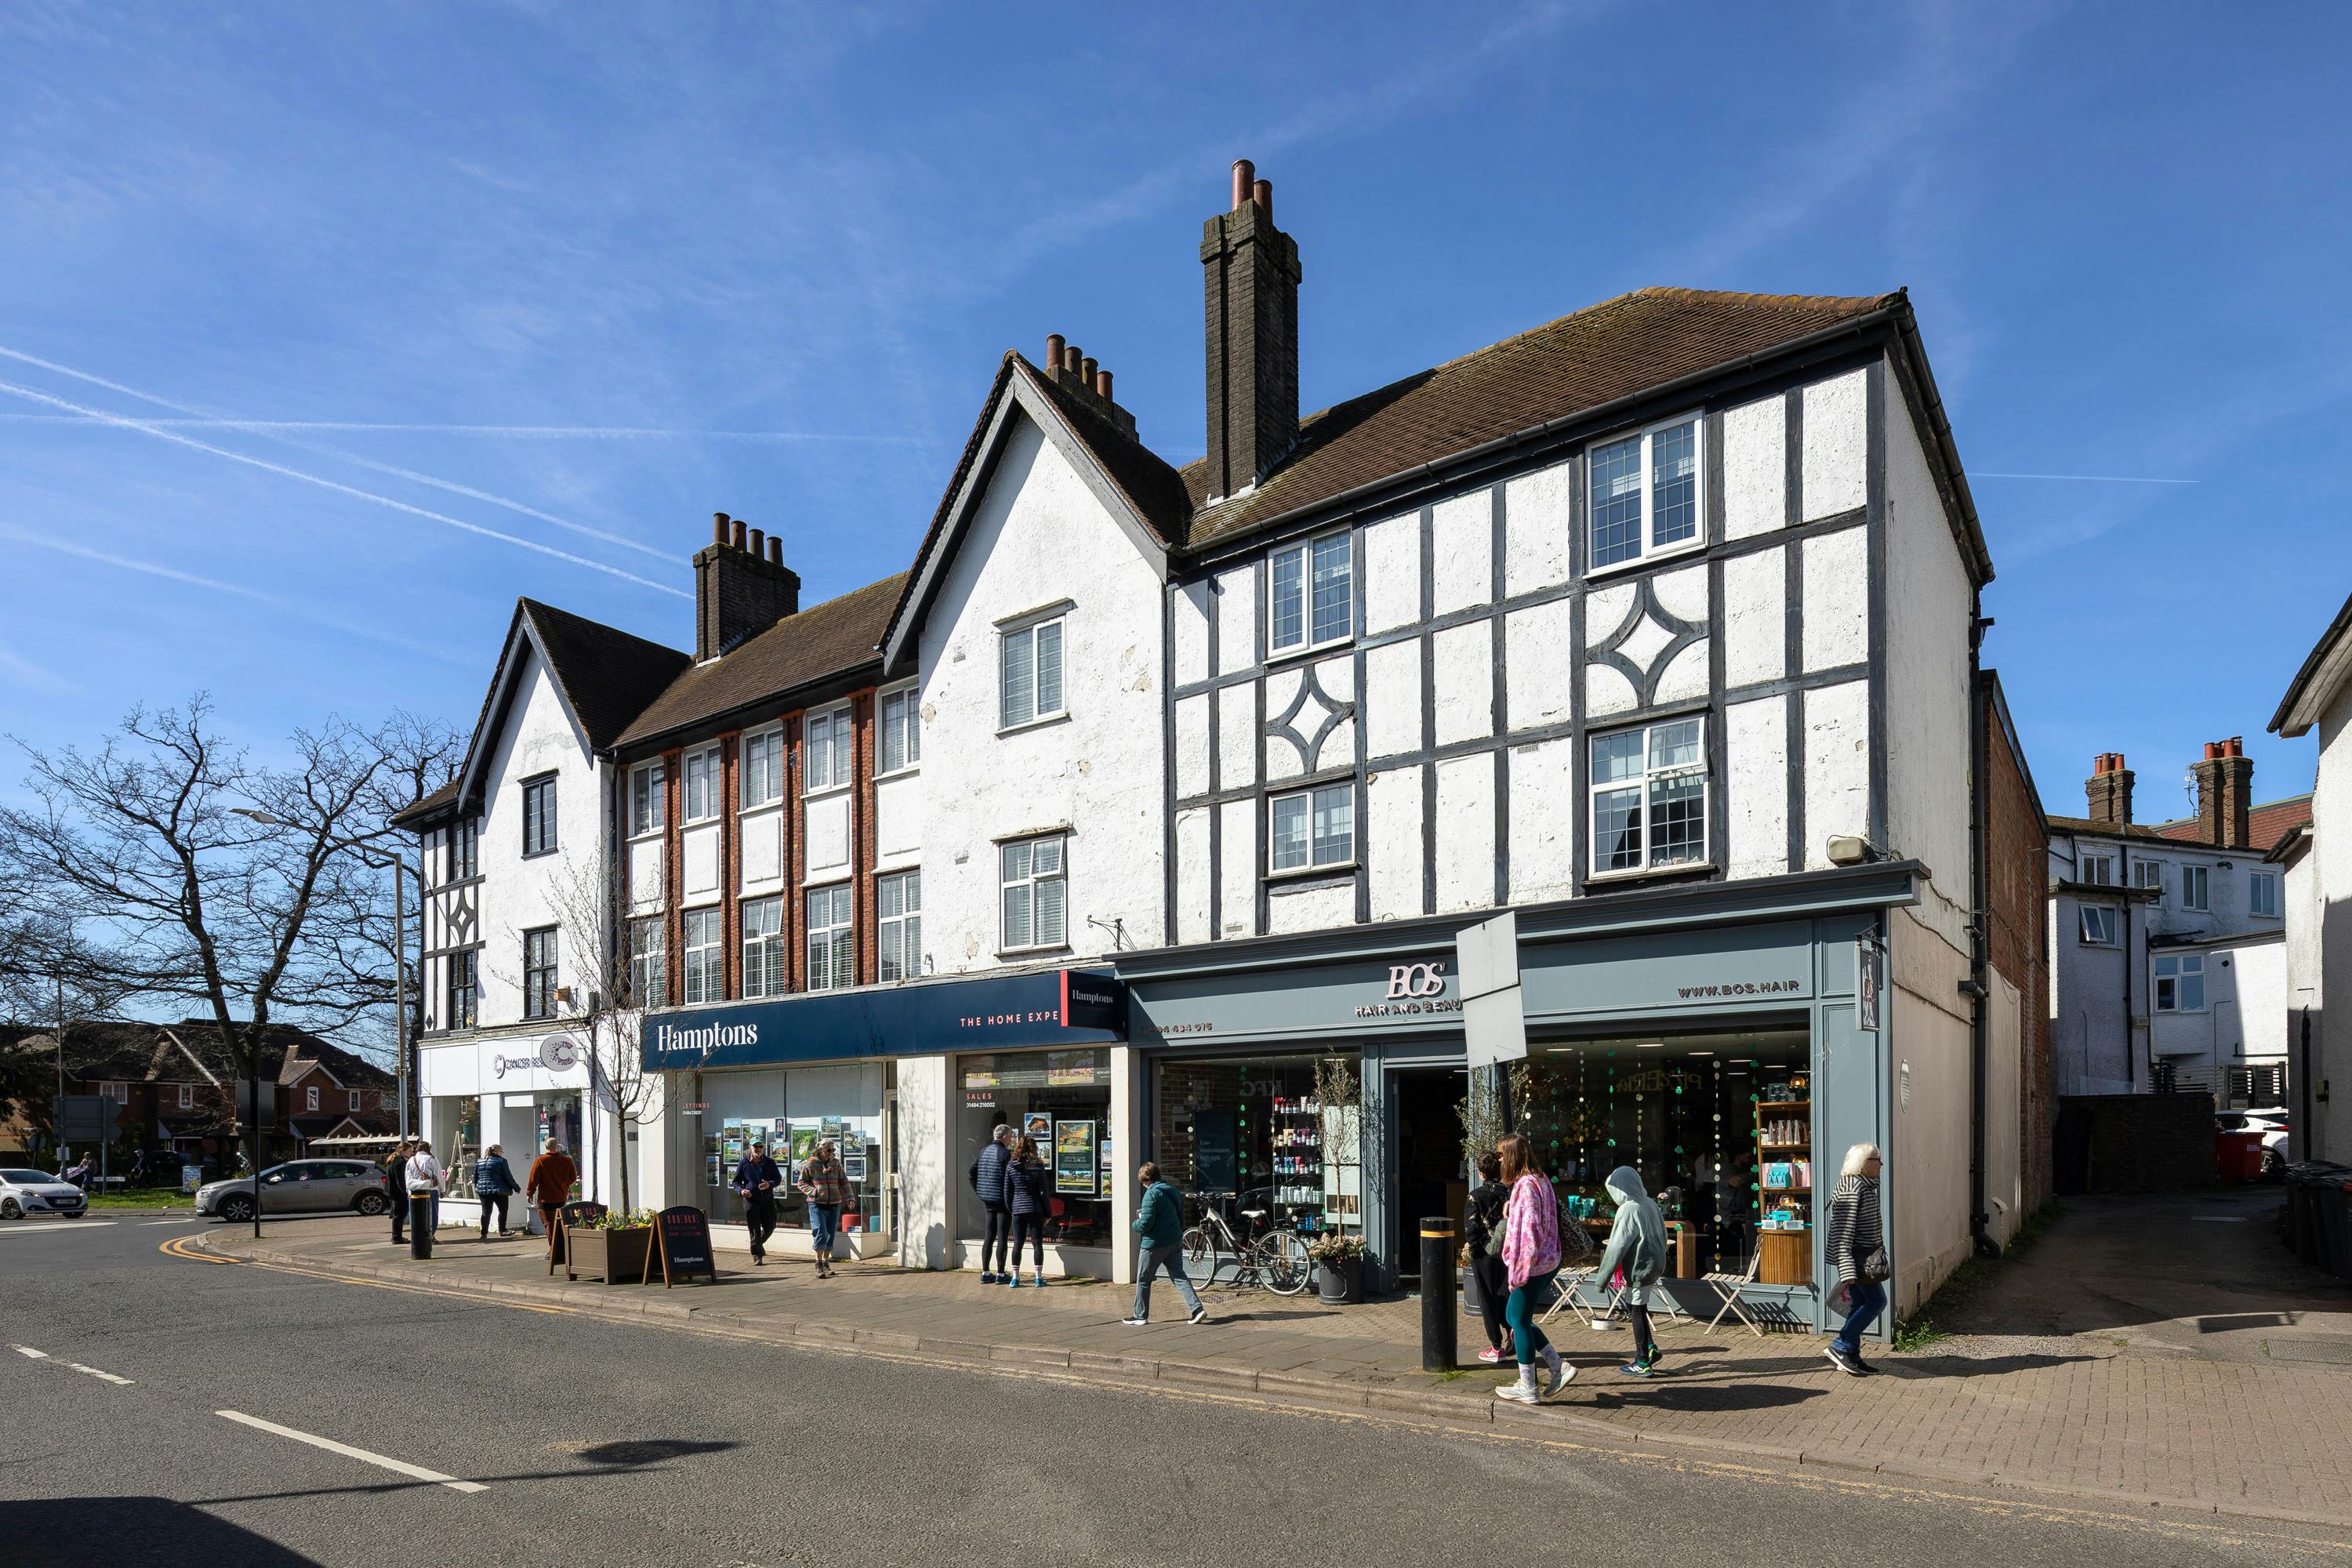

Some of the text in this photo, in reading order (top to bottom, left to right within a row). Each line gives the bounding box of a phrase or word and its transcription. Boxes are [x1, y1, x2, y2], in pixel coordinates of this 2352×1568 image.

[1385, 963, 1445, 999] BOS
[1678, 980, 1799, 998] WWW.BOS.HAIR
[1073, 989, 1113, 1004] Hamptons
[1355, 999, 1463, 1018] HAIR AND BEAU
[960, 1011, 1058, 1028] THE HOME EXPE
[658, 1021, 758, 1056] Hamptons
[673, 1256, 704, 1265] Hamptons
